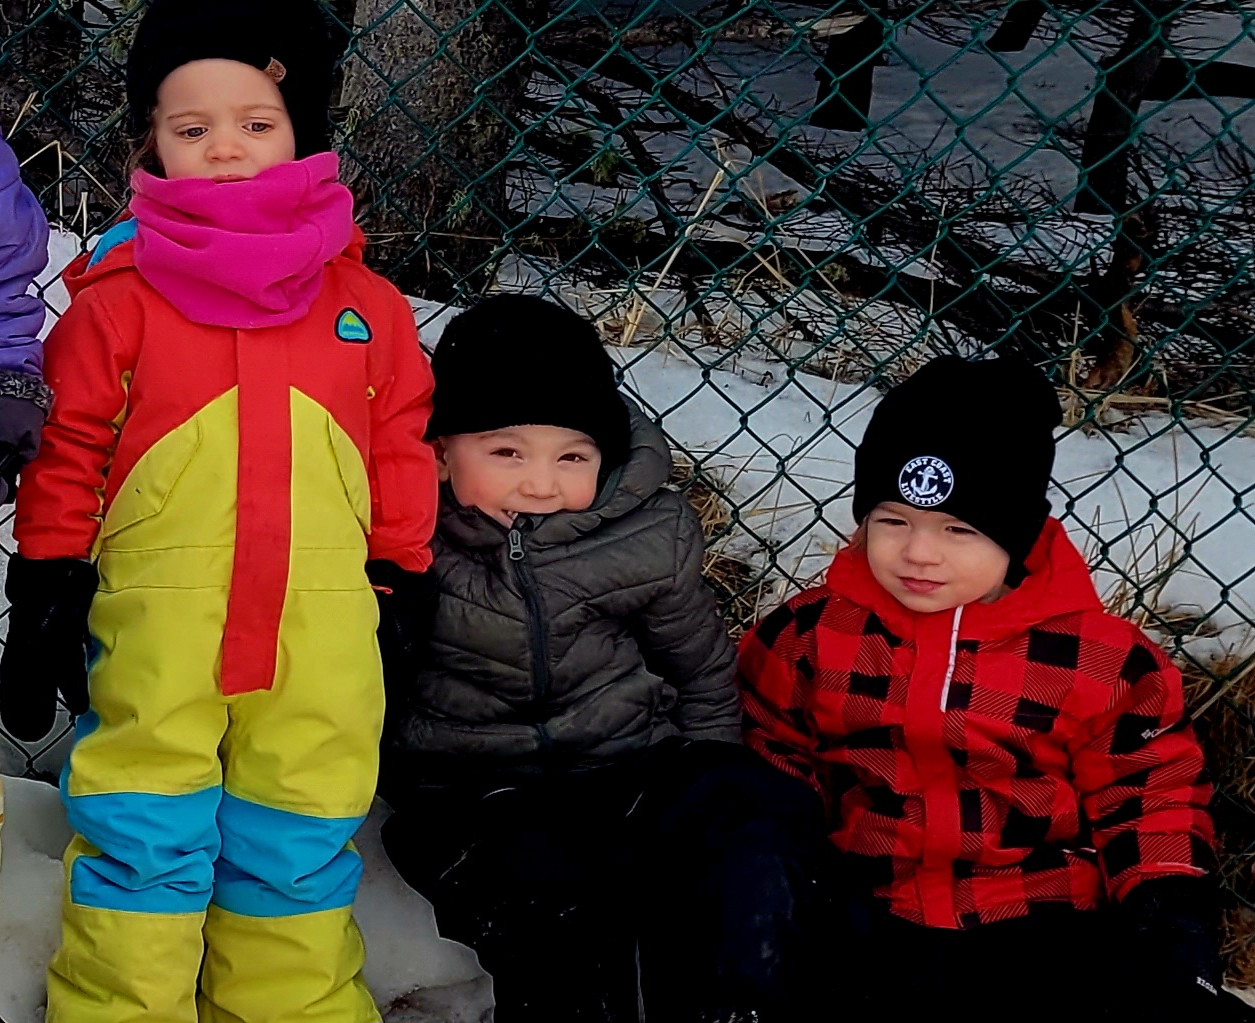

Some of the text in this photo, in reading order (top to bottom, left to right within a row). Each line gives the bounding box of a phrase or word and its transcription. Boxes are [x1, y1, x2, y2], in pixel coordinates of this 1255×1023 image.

[905, 458, 952, 484] EAST COAST
[901, 482, 944, 505] LIFESTYLE
